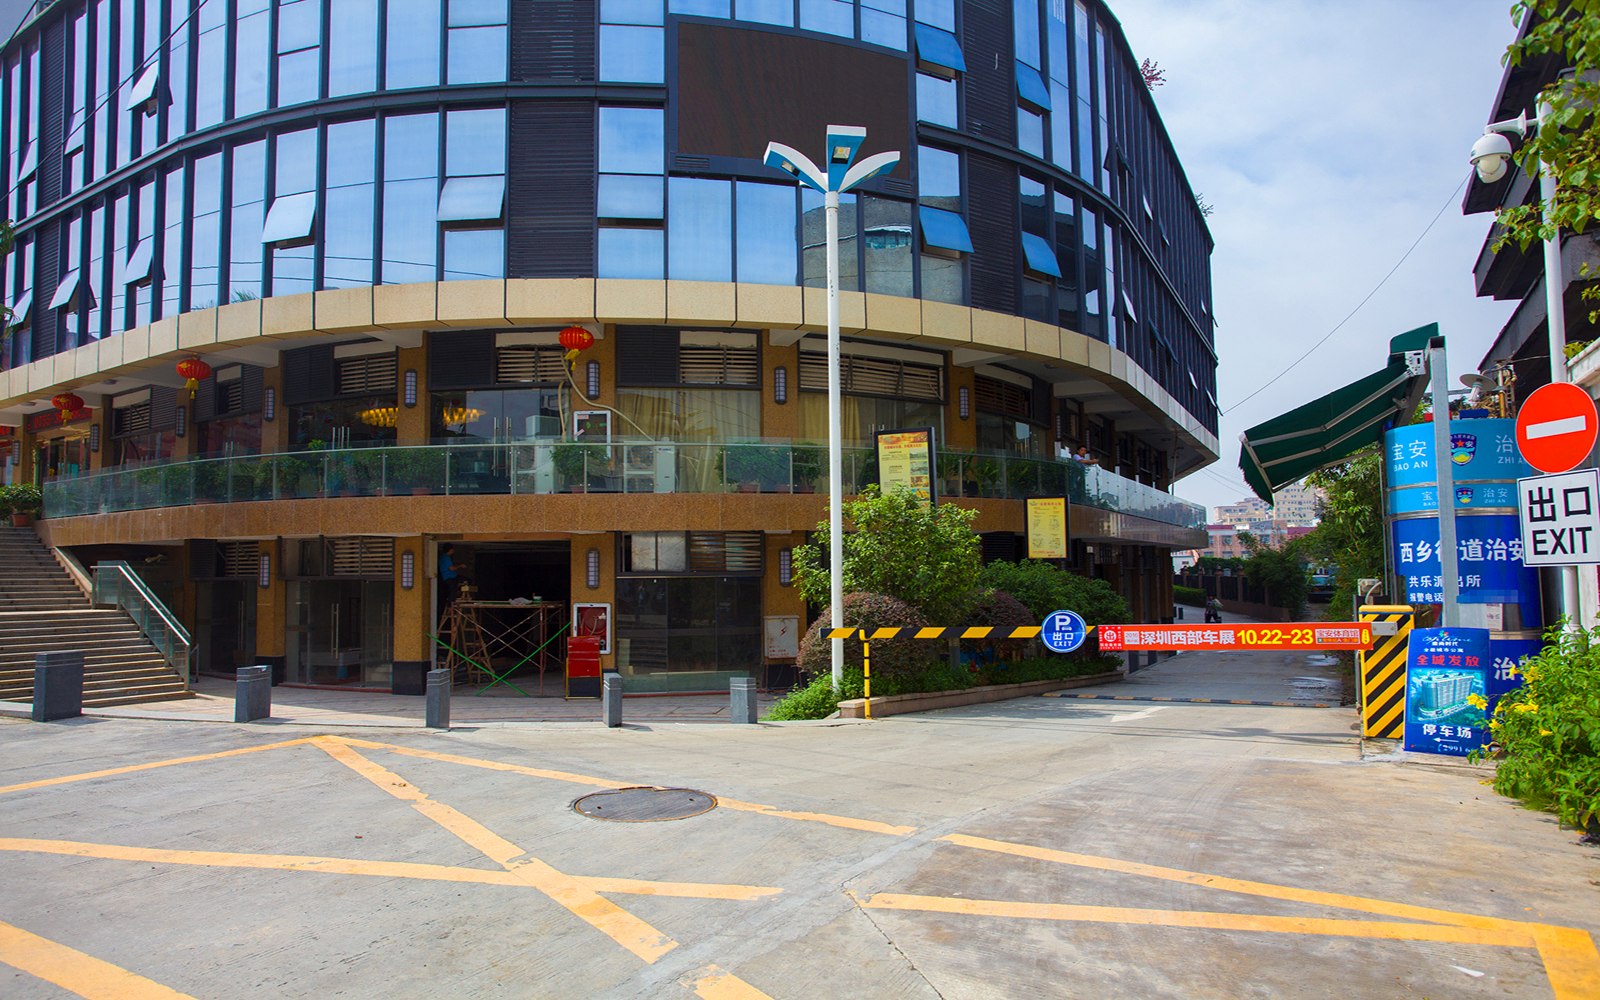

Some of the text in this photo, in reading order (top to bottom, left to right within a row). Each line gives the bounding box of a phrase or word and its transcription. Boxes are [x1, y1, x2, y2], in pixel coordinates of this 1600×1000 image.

[1392, 439, 1427, 461] 宝安
[1413, 460, 1428, 469] AN
[1483, 488, 1508, 498] 治安
[1528, 486, 1592, 523] 出口
[1532, 526, 1593, 556] EXIT
[1055, 615, 1071, 631] P
[1052, 631, 1074, 641] 出口
[1140, 628, 1314, 646] 深圳西部车展 10.22-23
[1422, 724, 1472, 739] 停车场
